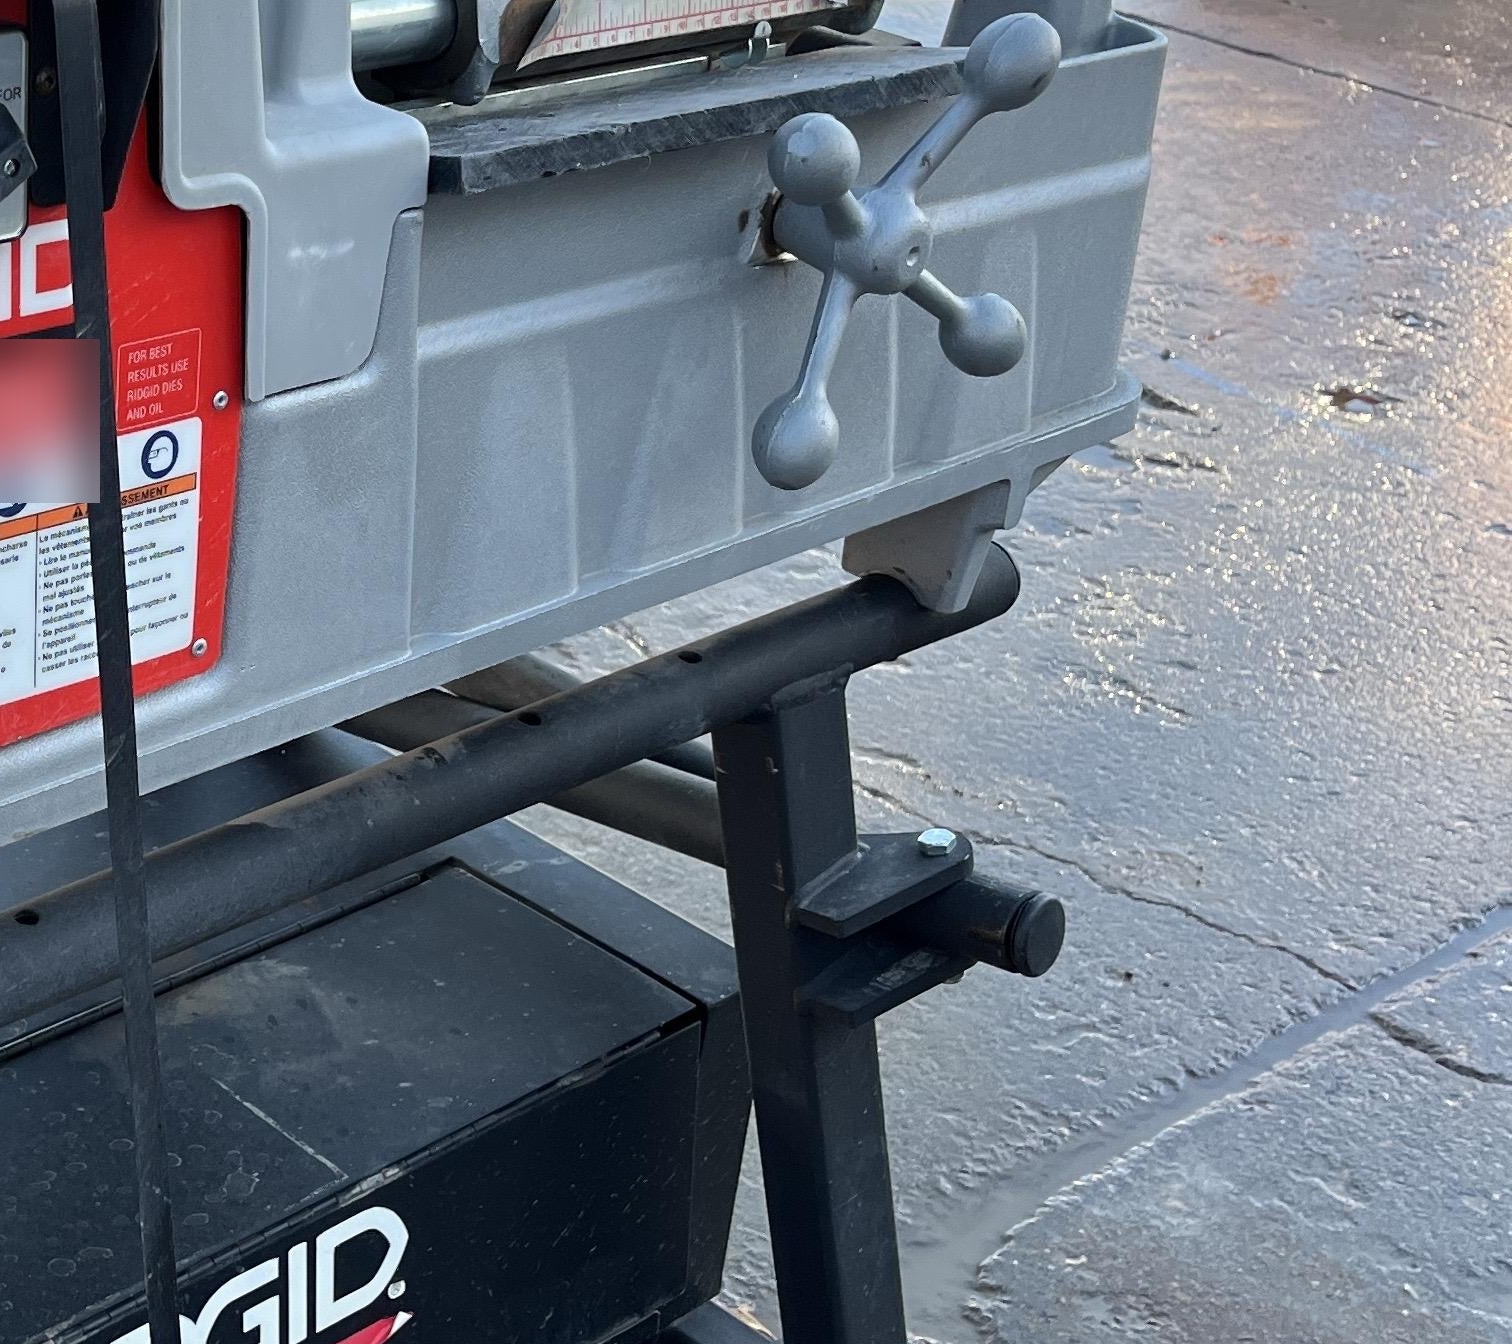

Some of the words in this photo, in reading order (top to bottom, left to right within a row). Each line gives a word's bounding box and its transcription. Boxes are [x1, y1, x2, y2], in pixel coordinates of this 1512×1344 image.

[128, 350, 146, 364] FOR
[149, 343, 173, 359] BEST
[128, 363, 168, 383] RESULTS
[171, 358, 189, 373] USE
[127, 384, 160, 401] RIDGID
[162, 379, 183, 394] DIES
[127, 406, 146, 421] AND
[149, 403, 163, 415] OIL
[122, 485, 169, 505] SSEMENT
[43, 593, 56, 602] mal
